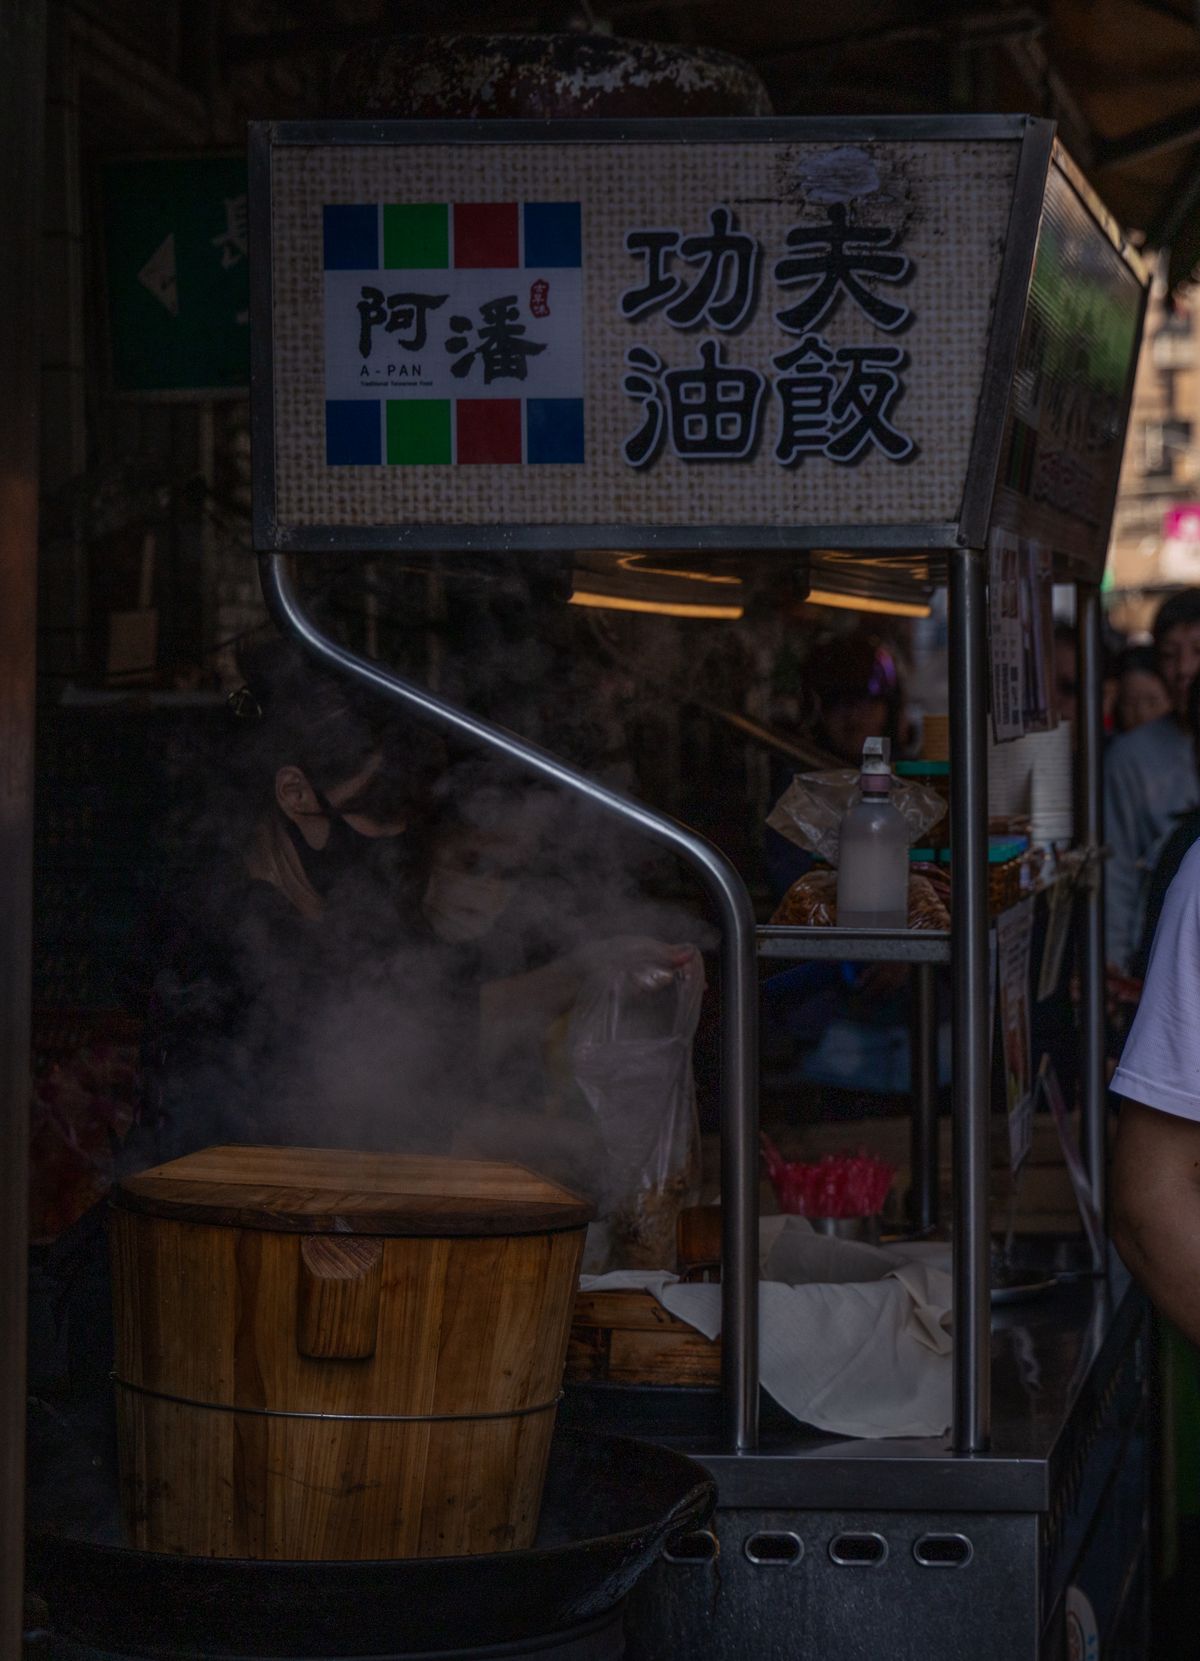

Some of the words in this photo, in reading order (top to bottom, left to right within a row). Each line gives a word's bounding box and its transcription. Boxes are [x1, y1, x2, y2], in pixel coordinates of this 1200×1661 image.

[621, 202, 912, 332] 功夫
[357, 286, 548, 384] 阿潘
[622, 334, 914, 467] 油飯
